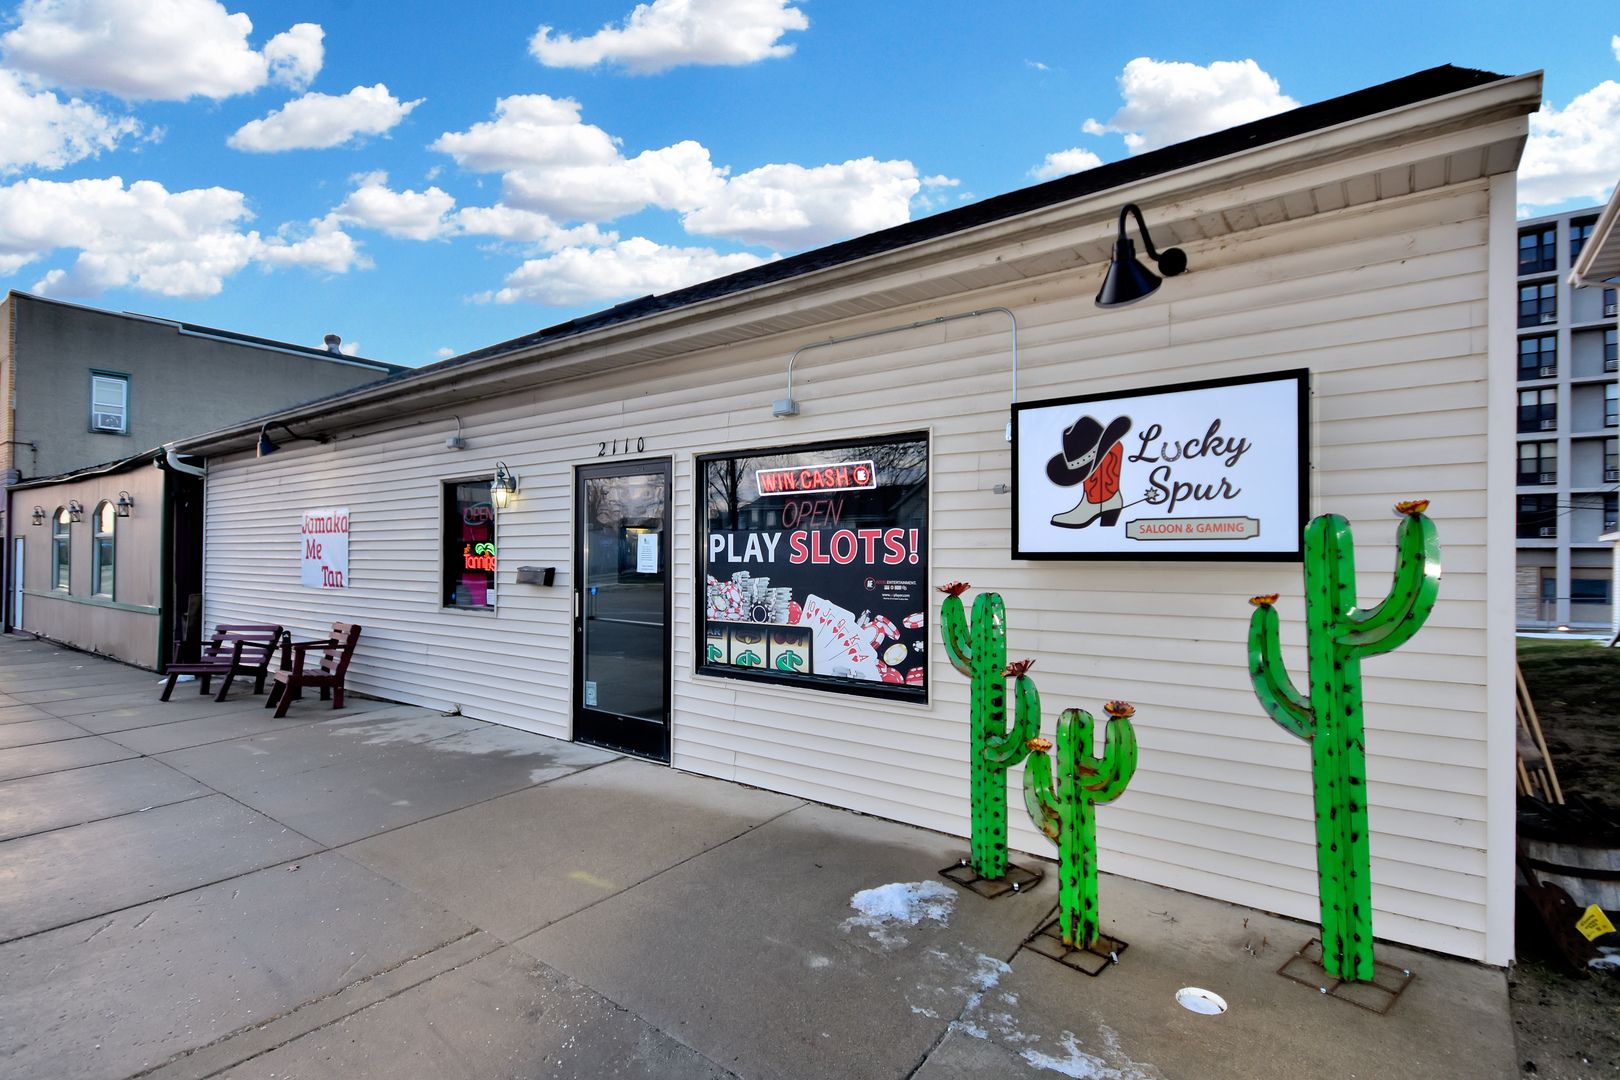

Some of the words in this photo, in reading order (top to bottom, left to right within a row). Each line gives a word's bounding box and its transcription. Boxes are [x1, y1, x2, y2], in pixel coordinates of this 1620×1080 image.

[598, 436, 645, 457] 2110
[1128, 418, 1252, 467] Lucky
[761, 471, 797, 492] WIN
[800, 466, 849, 490] CASH
[1145, 465, 1242, 514] Spur
[301, 511, 349, 534] Jamaka
[464, 506, 494, 521] OPEN
[782, 499, 844, 528] OPEN
[1139, 523, 1183, 534] SALOON
[1185, 524, 1194, 533] &
[1196, 522, 1245, 533] GAMING
[305, 538, 322, 560] Me
[709, 532, 782, 563] PLAY
[789, 528, 919, 565] SLOTS!
[463, 553, 497, 572] Tanning
[321, 565, 344, 588] Tan
